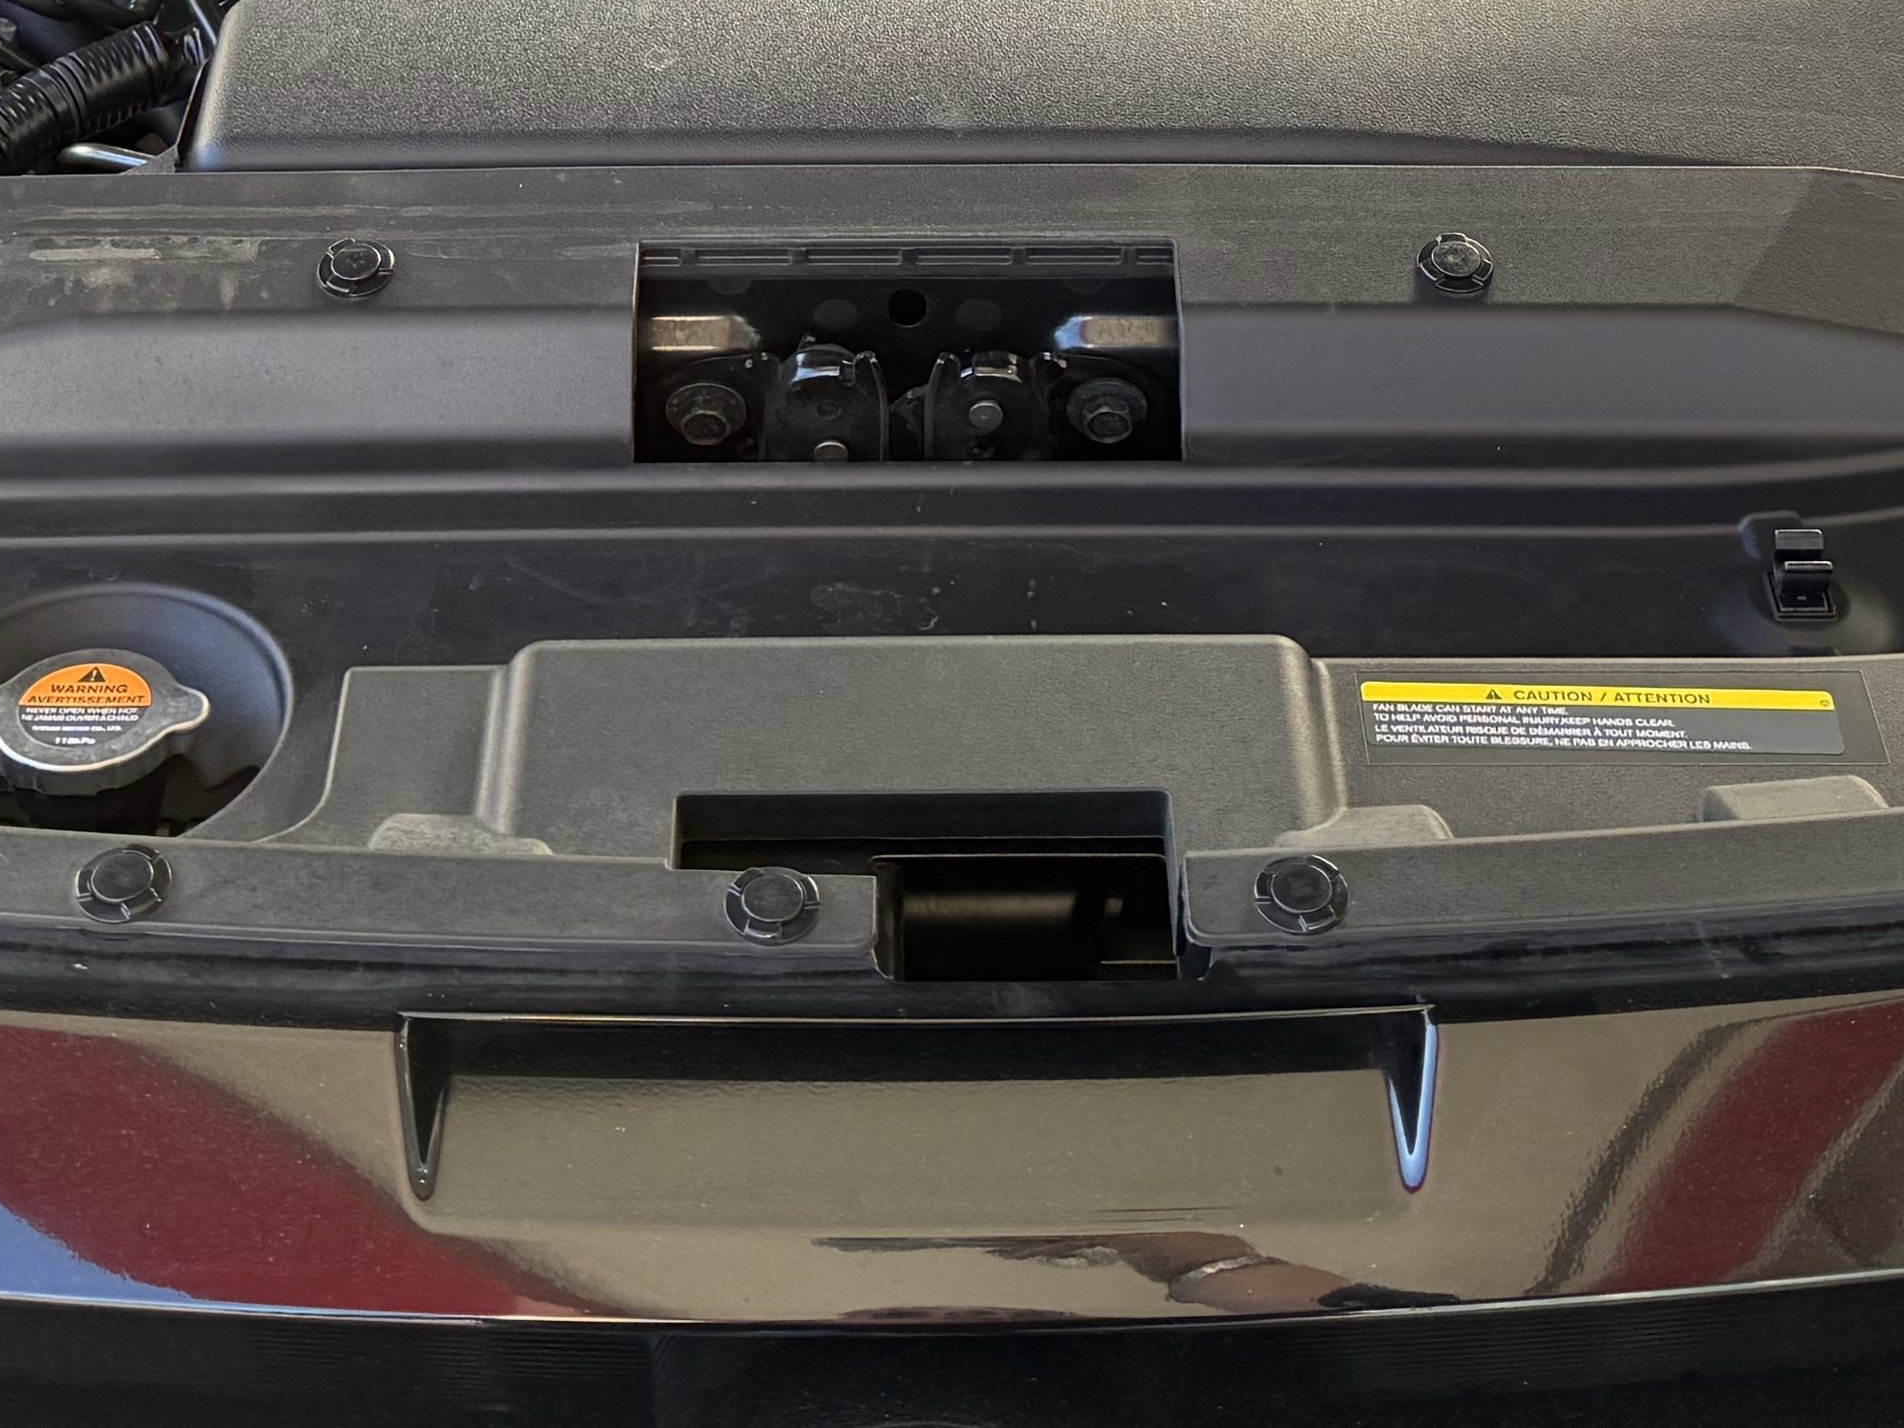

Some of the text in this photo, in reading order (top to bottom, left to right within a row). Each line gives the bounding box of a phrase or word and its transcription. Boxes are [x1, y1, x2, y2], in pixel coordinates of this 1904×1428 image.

[50, 684, 128, 694] WARNING
[27, 695, 145, 704] AVERTISSEMENT
[1513, 690, 1592, 702] CAUTION
[1614, 692, 1710, 704] ATTENTION
[1436, 704, 1460, 713] CAN
[1374, 713, 1389, 721] TO
[1604, 729, 1633, 738] TOUT
[1376, 734, 1409, 744] POUR
